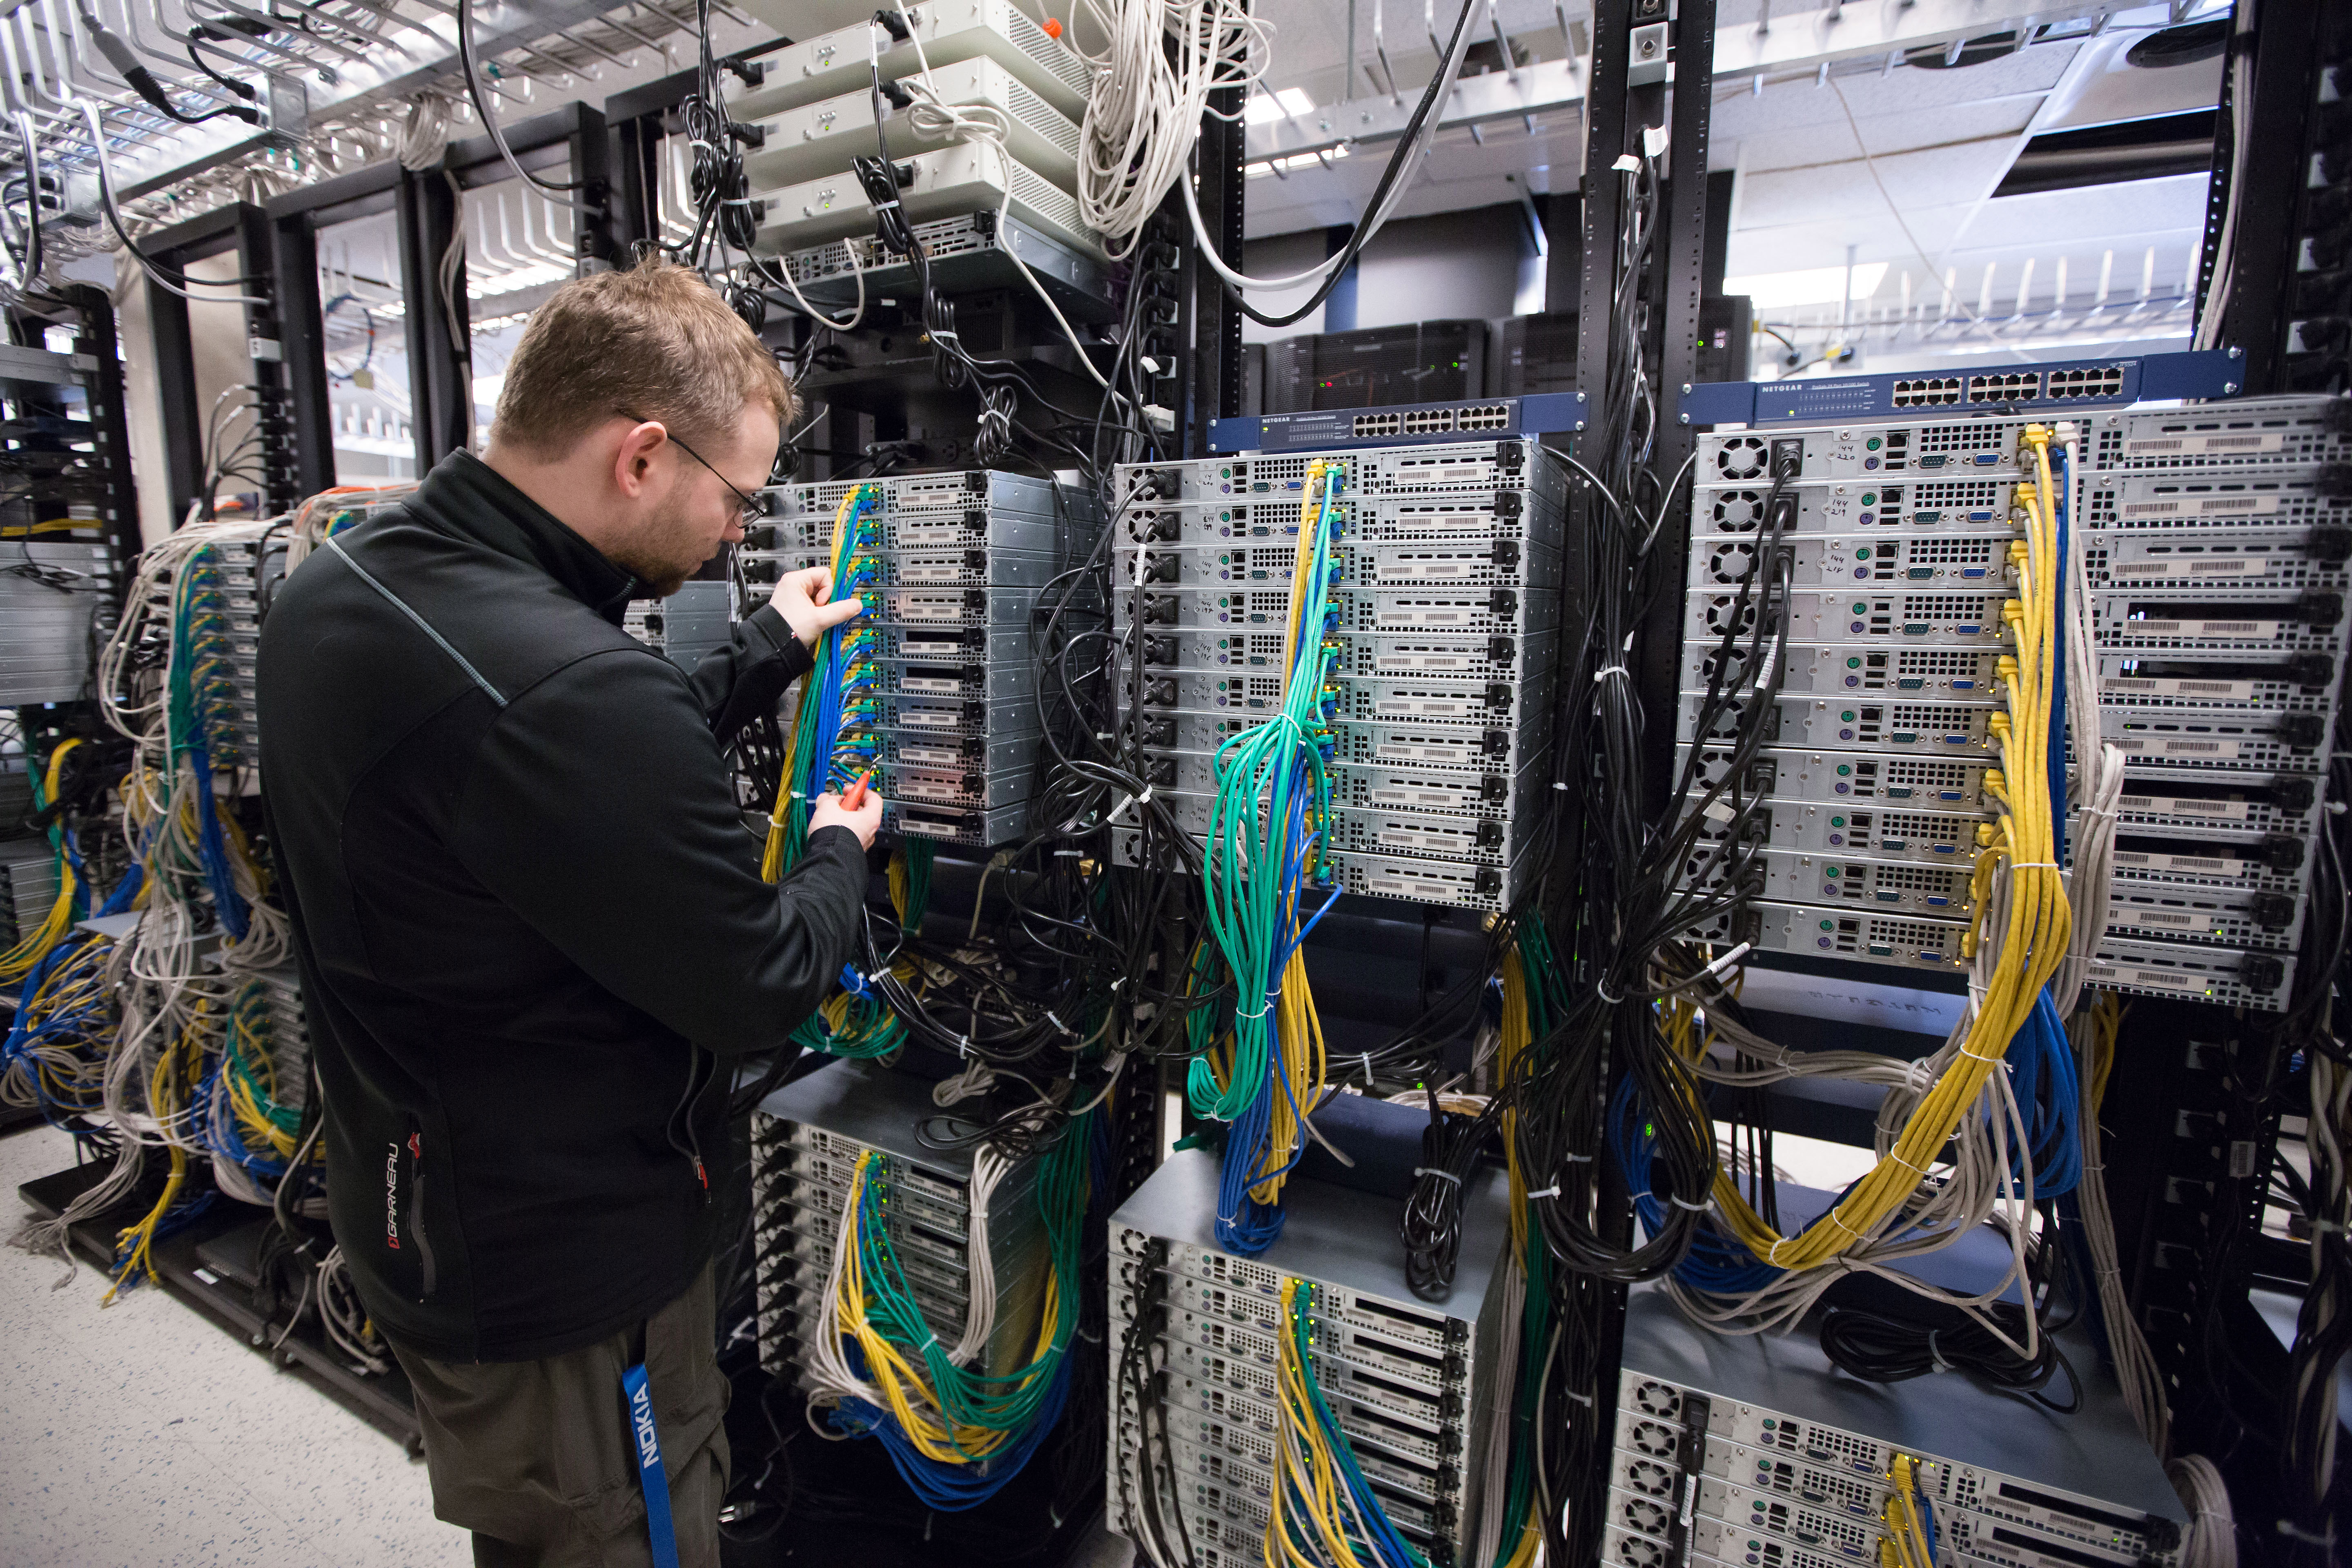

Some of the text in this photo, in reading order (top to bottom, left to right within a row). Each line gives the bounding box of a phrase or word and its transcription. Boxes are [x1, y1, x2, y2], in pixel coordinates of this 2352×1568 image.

[1830, 555, 1844, 563] 144
[1315, 615, 1323, 640] TECHNOLOGY
[387, 1143, 398, 1238] GARNEAU
[633, 1382, 659, 1469] NOKIA
